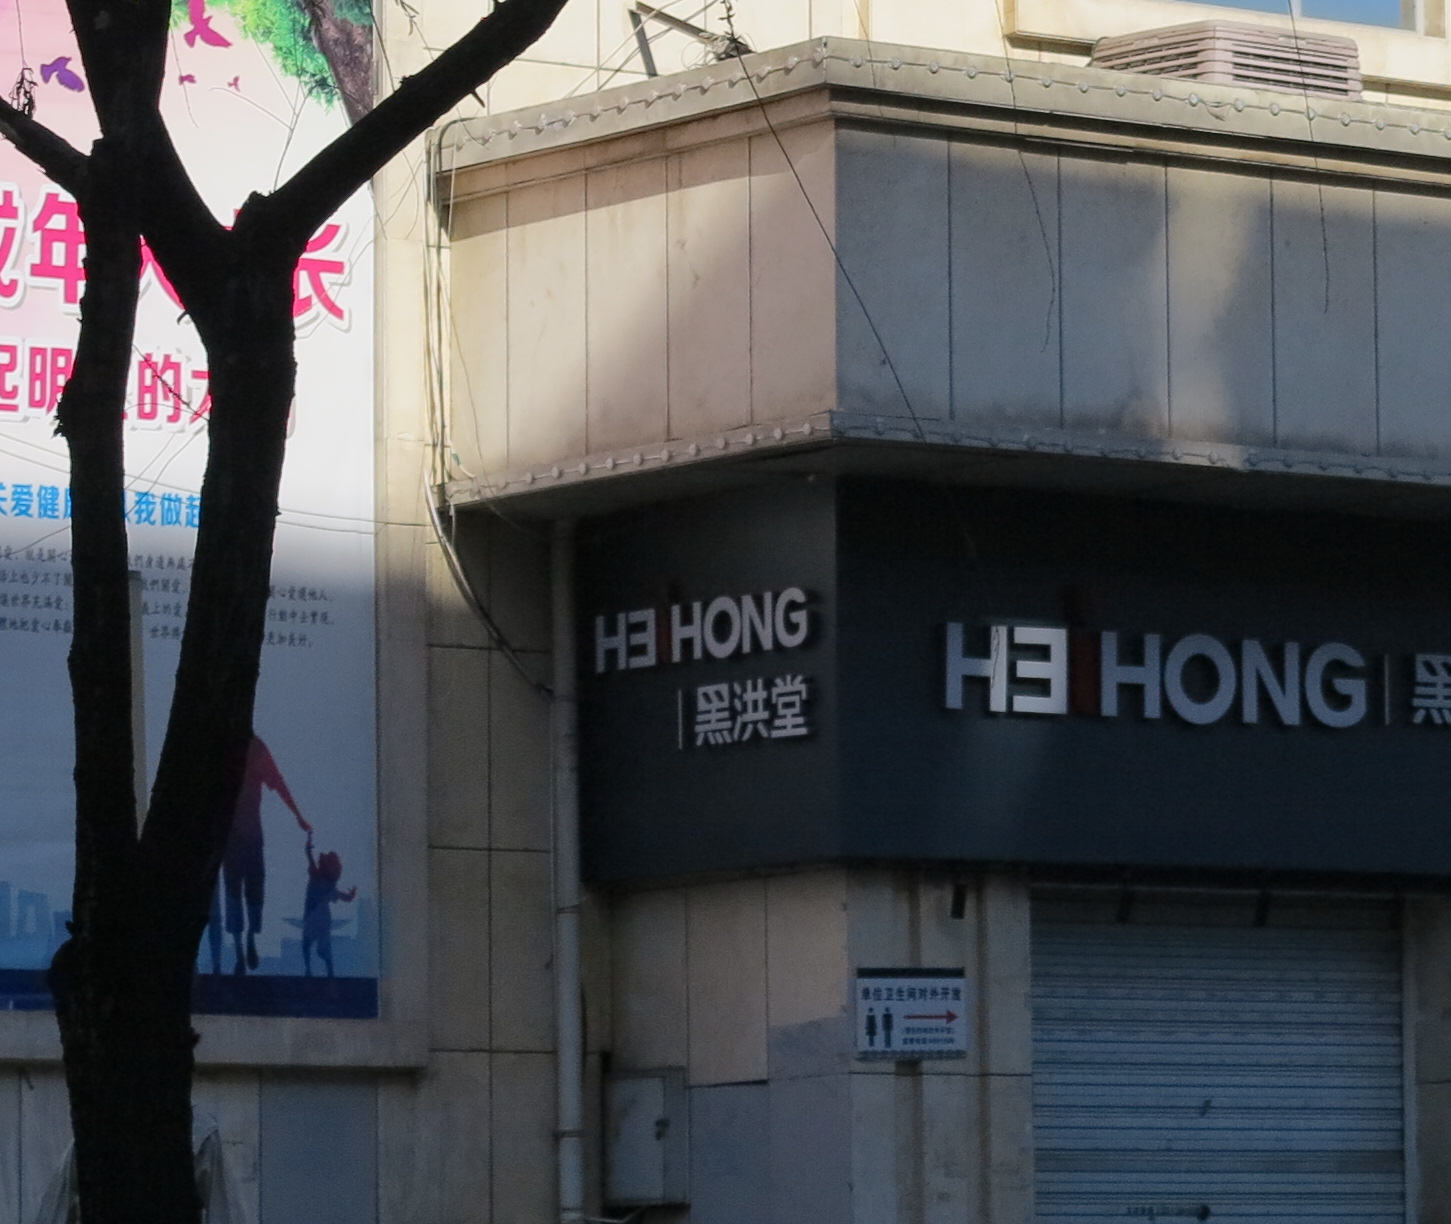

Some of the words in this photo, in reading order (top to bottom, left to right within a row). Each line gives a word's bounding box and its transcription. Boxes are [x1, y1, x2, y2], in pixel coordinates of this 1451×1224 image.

[671, 587, 808, 664] HONG
[694, 674, 808, 746] 黑洪堂
[1100, 631, 1368, 729] HONG
[861, 986, 961, 1001] 单位卫生间对外开放
